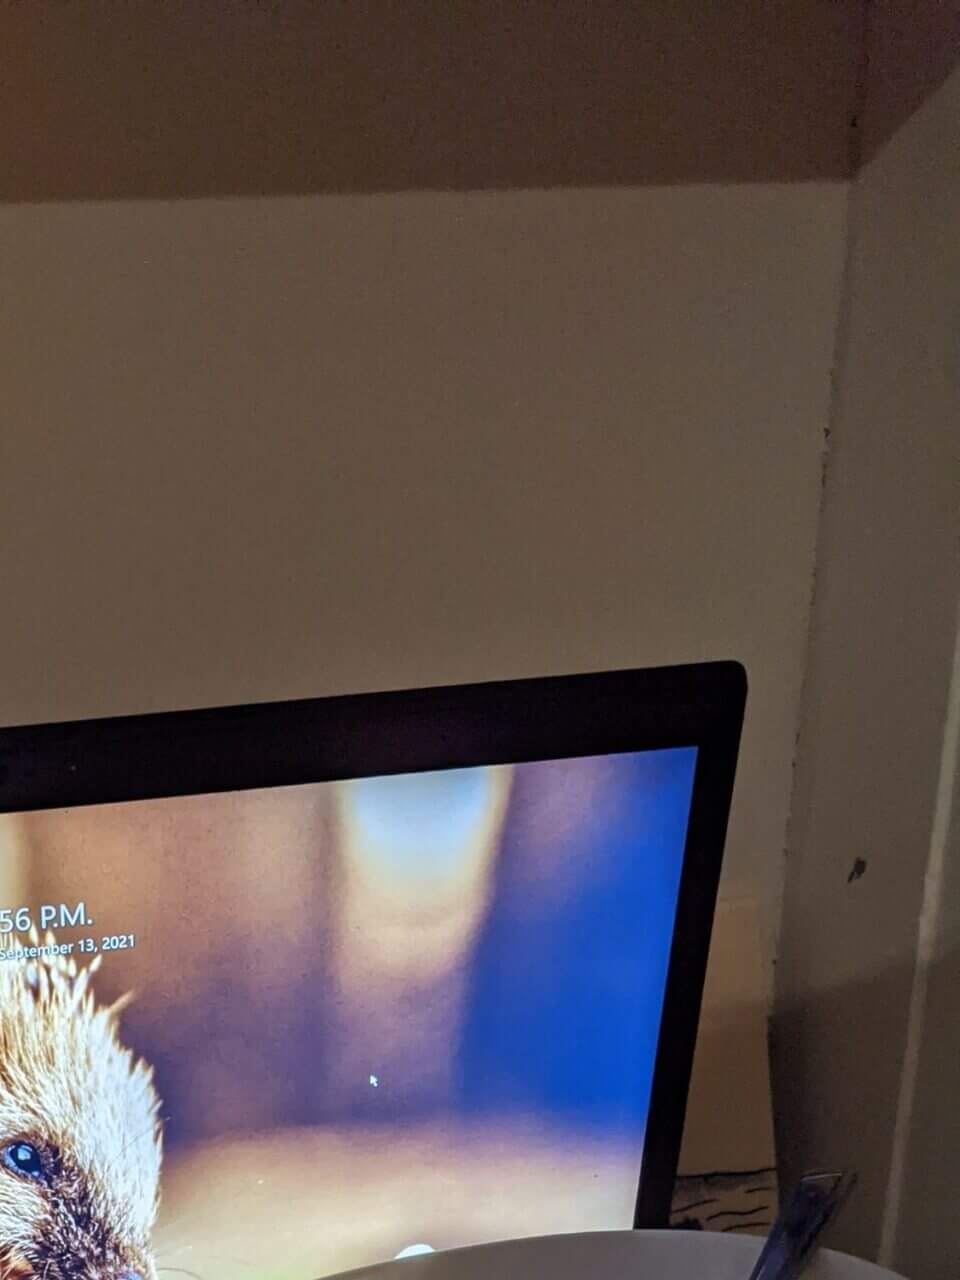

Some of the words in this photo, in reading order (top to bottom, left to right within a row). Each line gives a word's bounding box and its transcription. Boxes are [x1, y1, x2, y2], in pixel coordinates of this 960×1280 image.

[40, 902, 93, 929] P.M.
[78, 939, 98, 953] 13,
[102, 934, 136, 951] 2021
